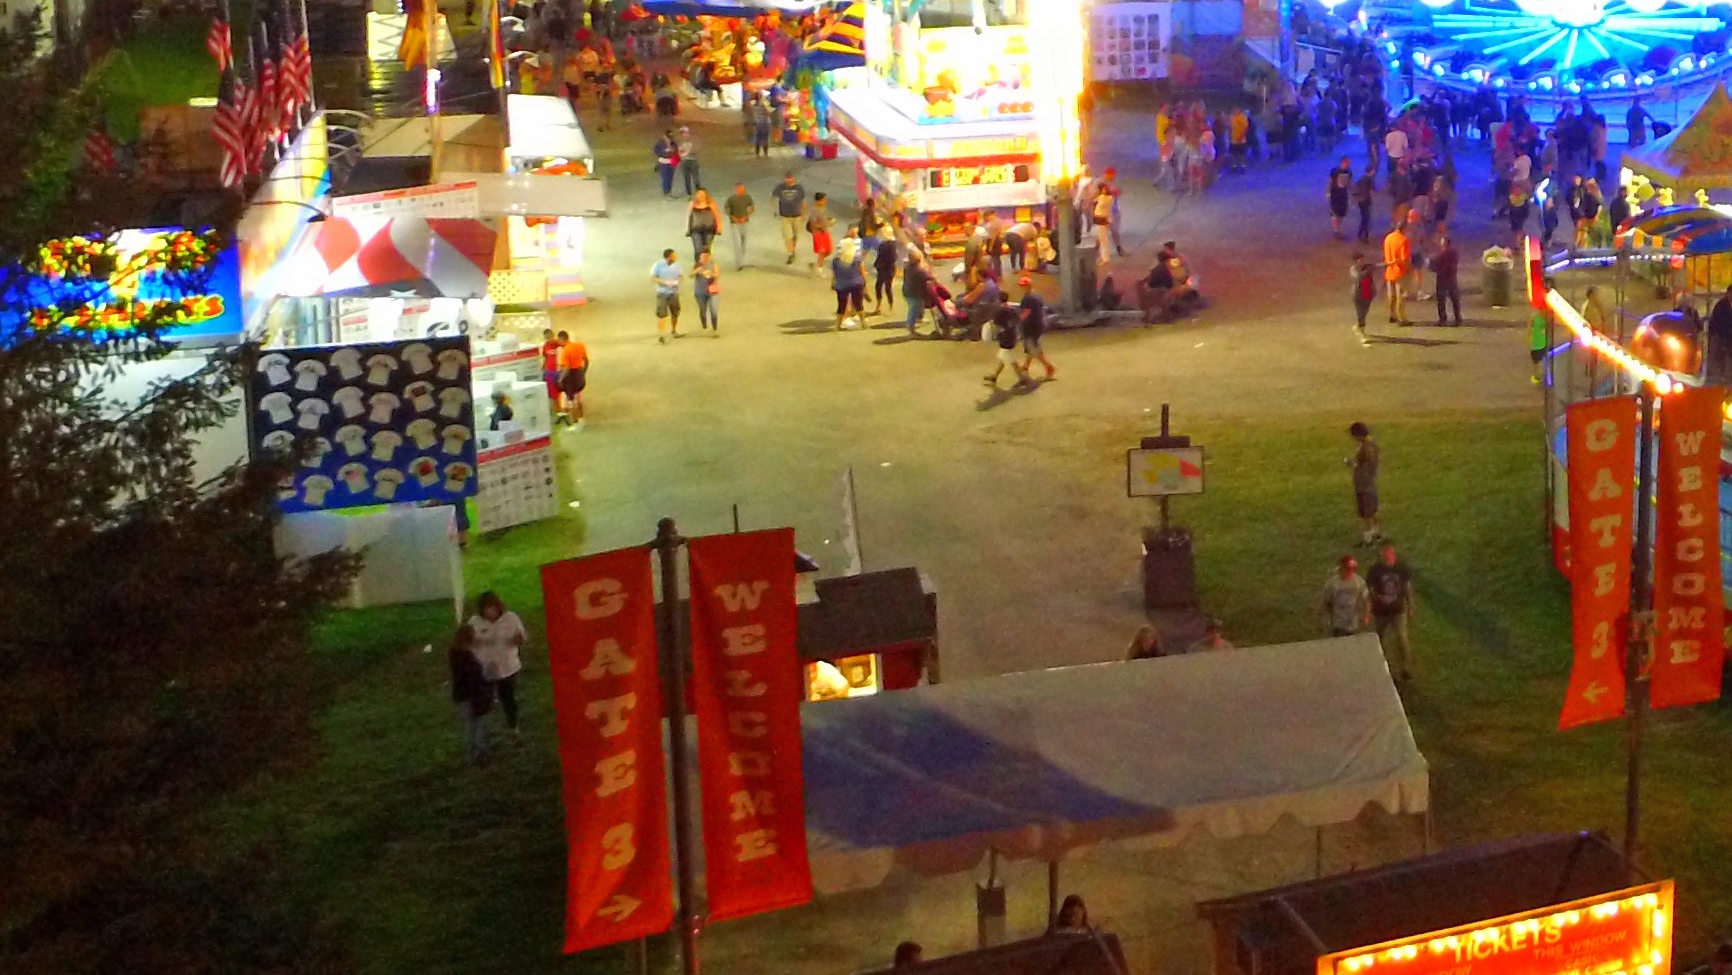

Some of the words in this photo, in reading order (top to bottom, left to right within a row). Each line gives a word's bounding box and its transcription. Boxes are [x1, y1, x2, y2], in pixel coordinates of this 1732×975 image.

[1585, 418, 1622, 597] GATE
[1668, 429, 1706, 664] WELCOME
[573, 577, 638, 797] GATE
[714, 580, 778, 862] WELCOME
[602, 822, 636, 871] 3
[1454, 921, 1562, 962] TICKETS
